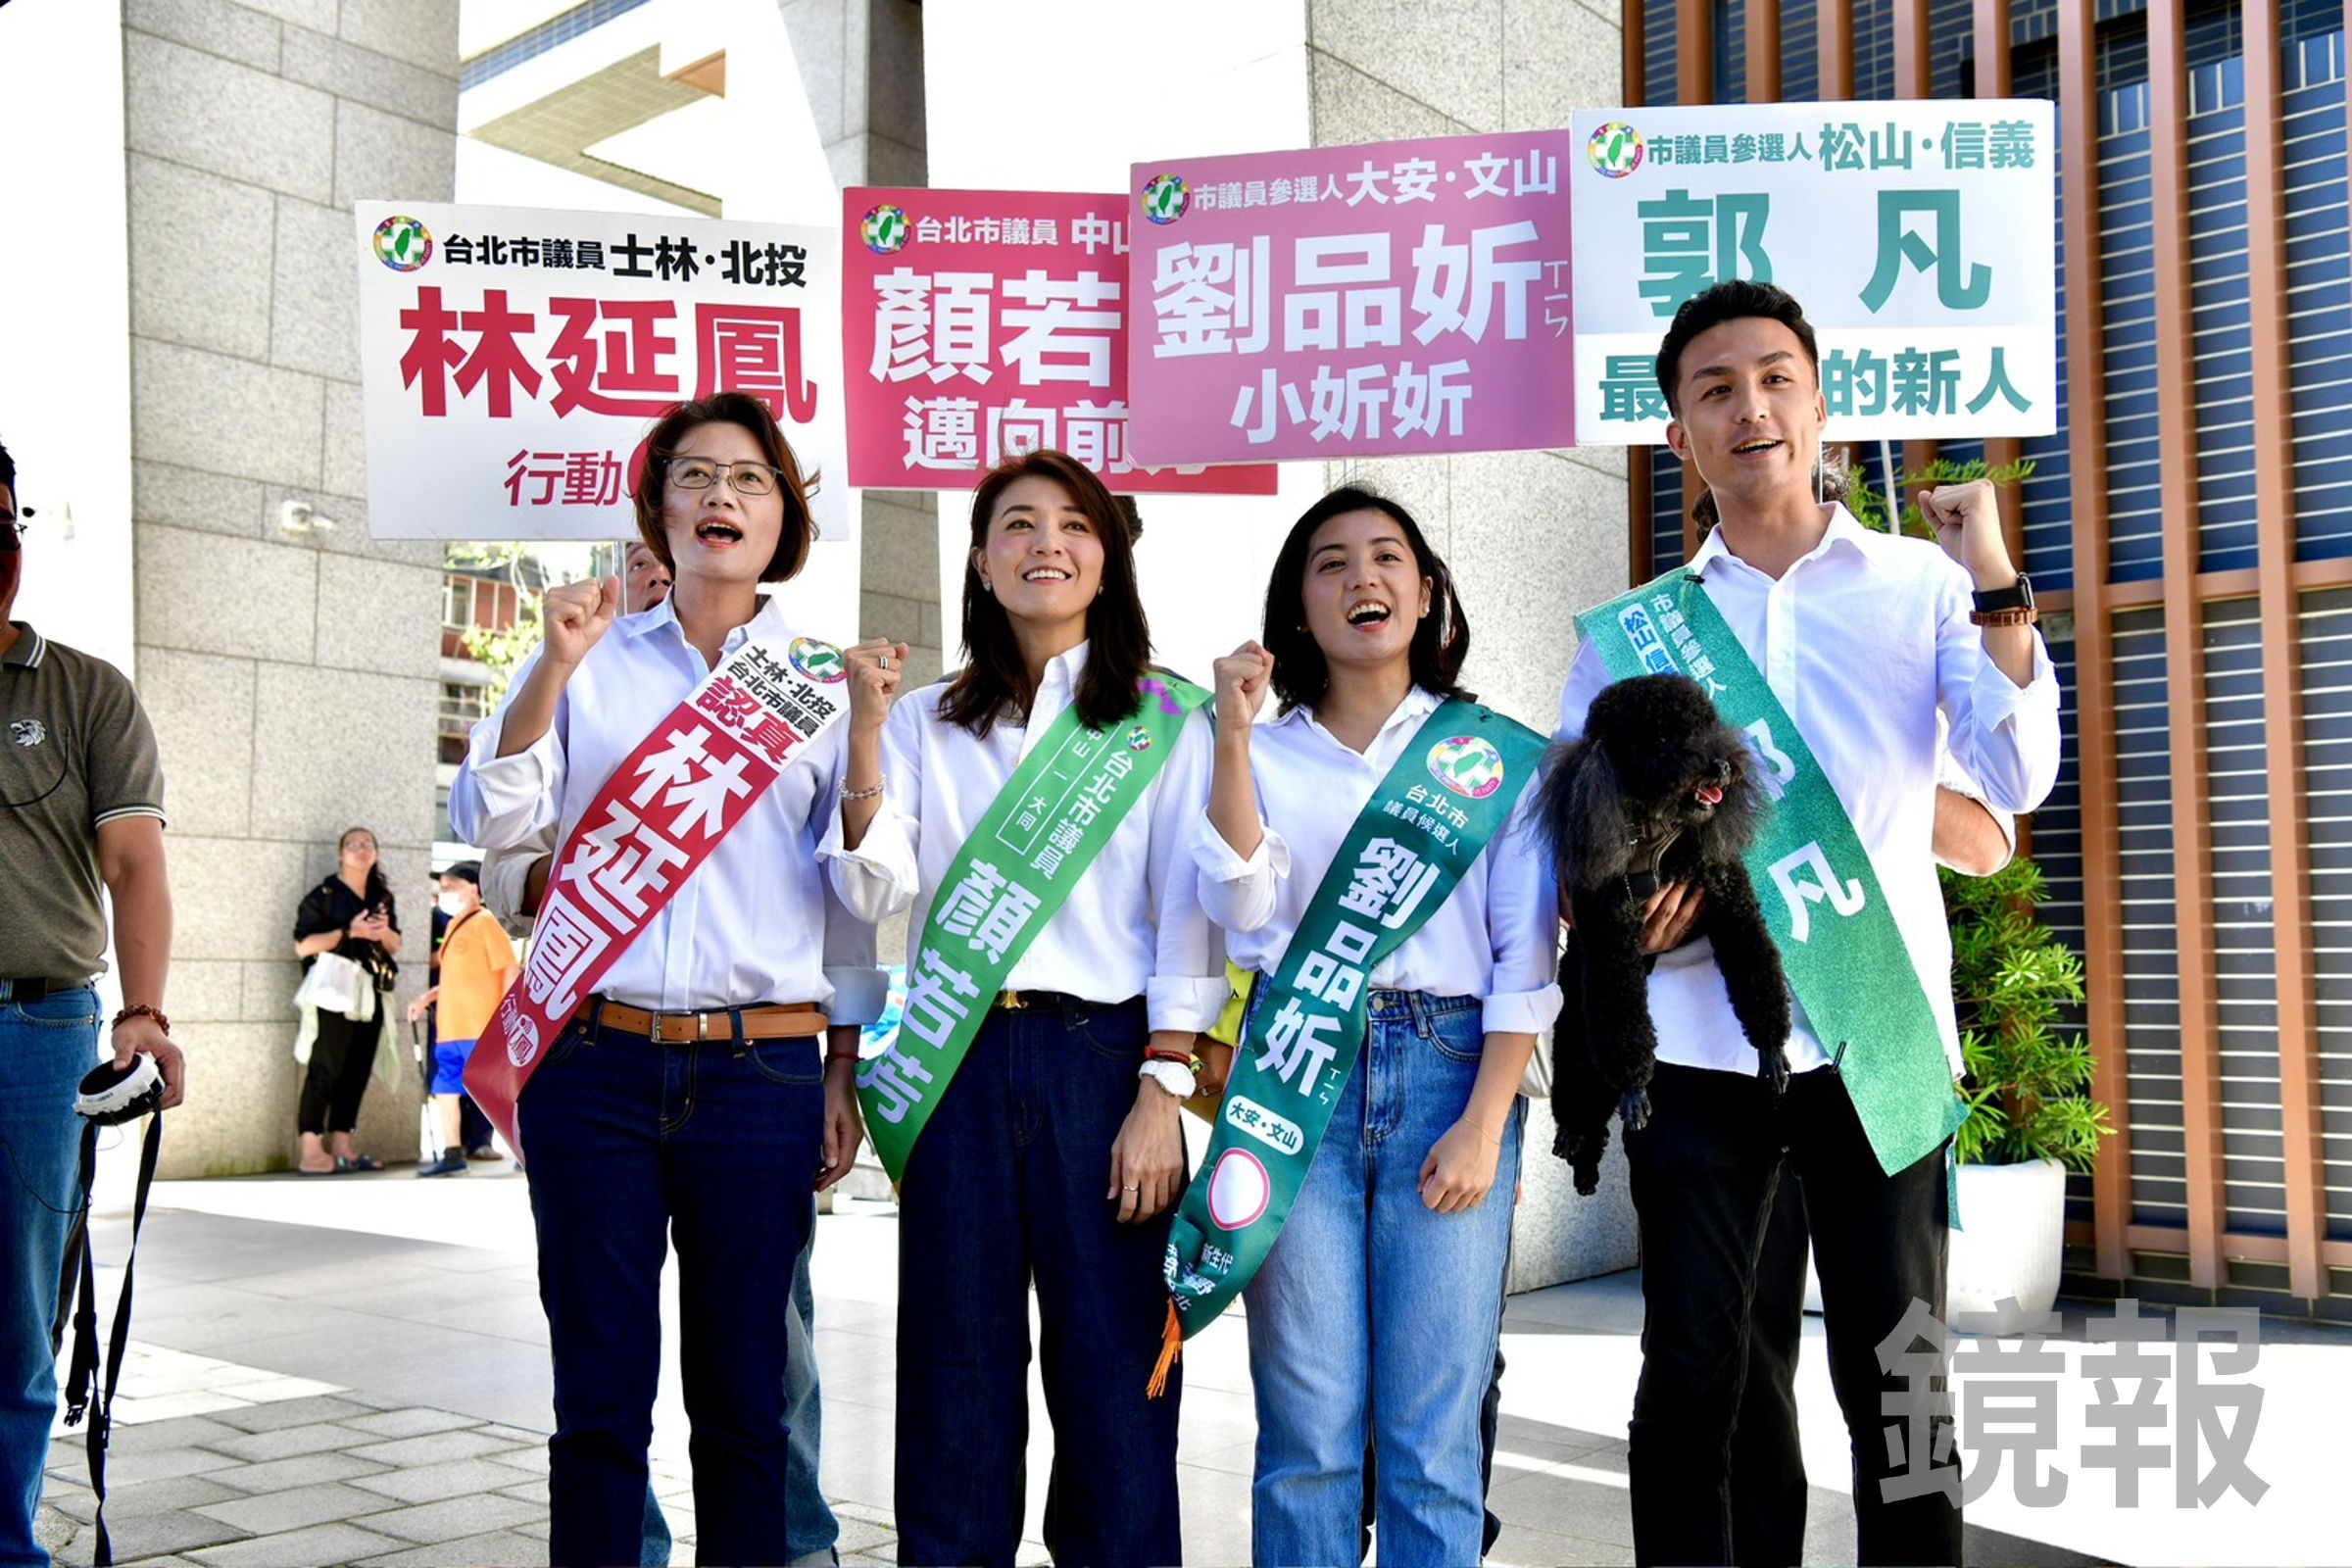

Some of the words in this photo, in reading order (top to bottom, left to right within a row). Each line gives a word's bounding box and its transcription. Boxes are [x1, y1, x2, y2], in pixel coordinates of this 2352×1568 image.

[1647, 130, 1813, 167] 市議員參選人
[915, 217, 1058, 247] 台北市議員
[1194, 176, 1344, 212] 市議員參選人
[443, 234, 606, 270] 台北市議員
[1152, 220, 1543, 359] 劉品妡
[400, 285, 818, 424] 林延鳳
[869, 267, 1122, 389] 顏若
[1229, 359, 1473, 444] 小妡妡
[1599, 347, 2034, 422] 最的新人
[903, 395, 1206, 476] 邁向前
[504, 449, 621, 507] 行動
[697, 675, 805, 765] 認真
[727, 661, 819, 738] 台北市議員
[1030, 750, 1134, 880] 台北市議員
[1382, 800, 1461, 857] 議員候選人
[1404, 784, 1470, 830] 台北市
[524, 723, 754, 1020] 林延鳳
[856, 857, 1043, 1125] 顏若芳
[1255, 836, 1442, 1098] 劉品妡
